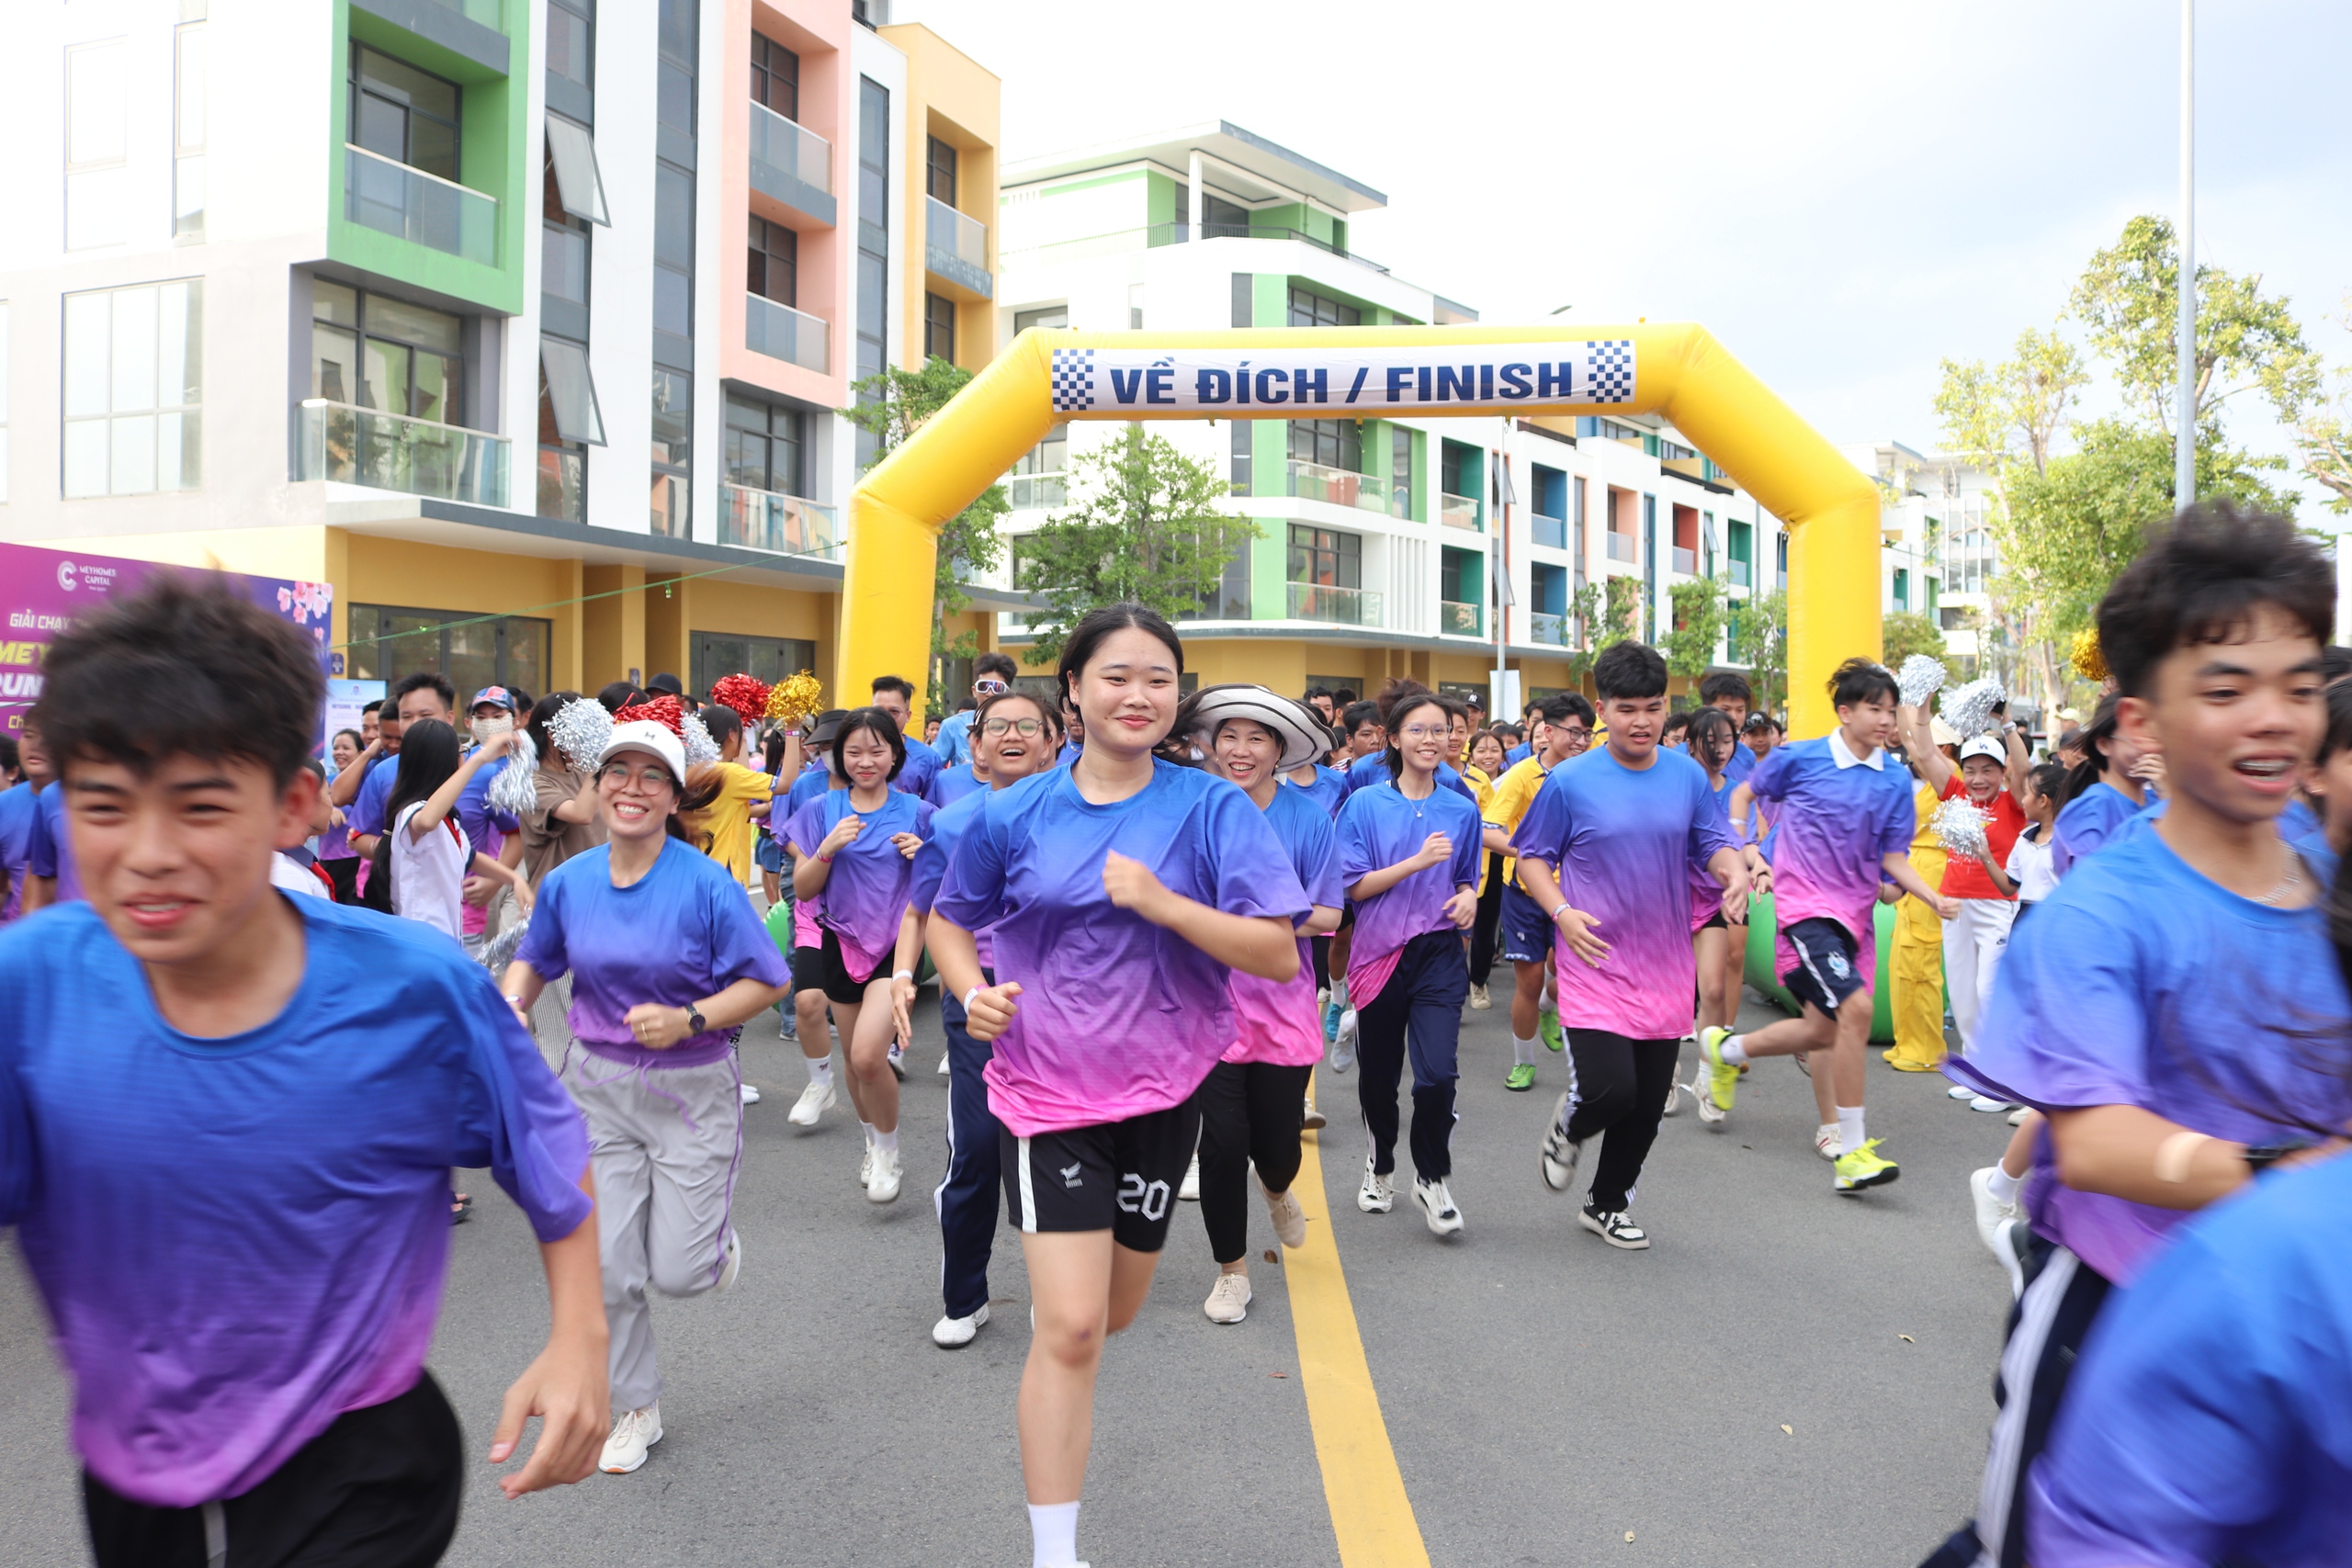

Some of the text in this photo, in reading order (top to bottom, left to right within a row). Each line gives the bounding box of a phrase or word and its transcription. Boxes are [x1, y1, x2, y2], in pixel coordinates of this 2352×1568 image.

[1110, 356, 1176, 404] VỀ
[1195, 360, 1328, 404] ĐÍCH
[1386, 361, 1572, 402] FINISH
[79, 565, 116, 577] MEYHOMES
[85, 575, 111, 586] CAPITAL
[9, 608, 35, 629] GIẢI
[0, 672, 45, 698] UN
[1116, 1172, 1170, 1222] 20
